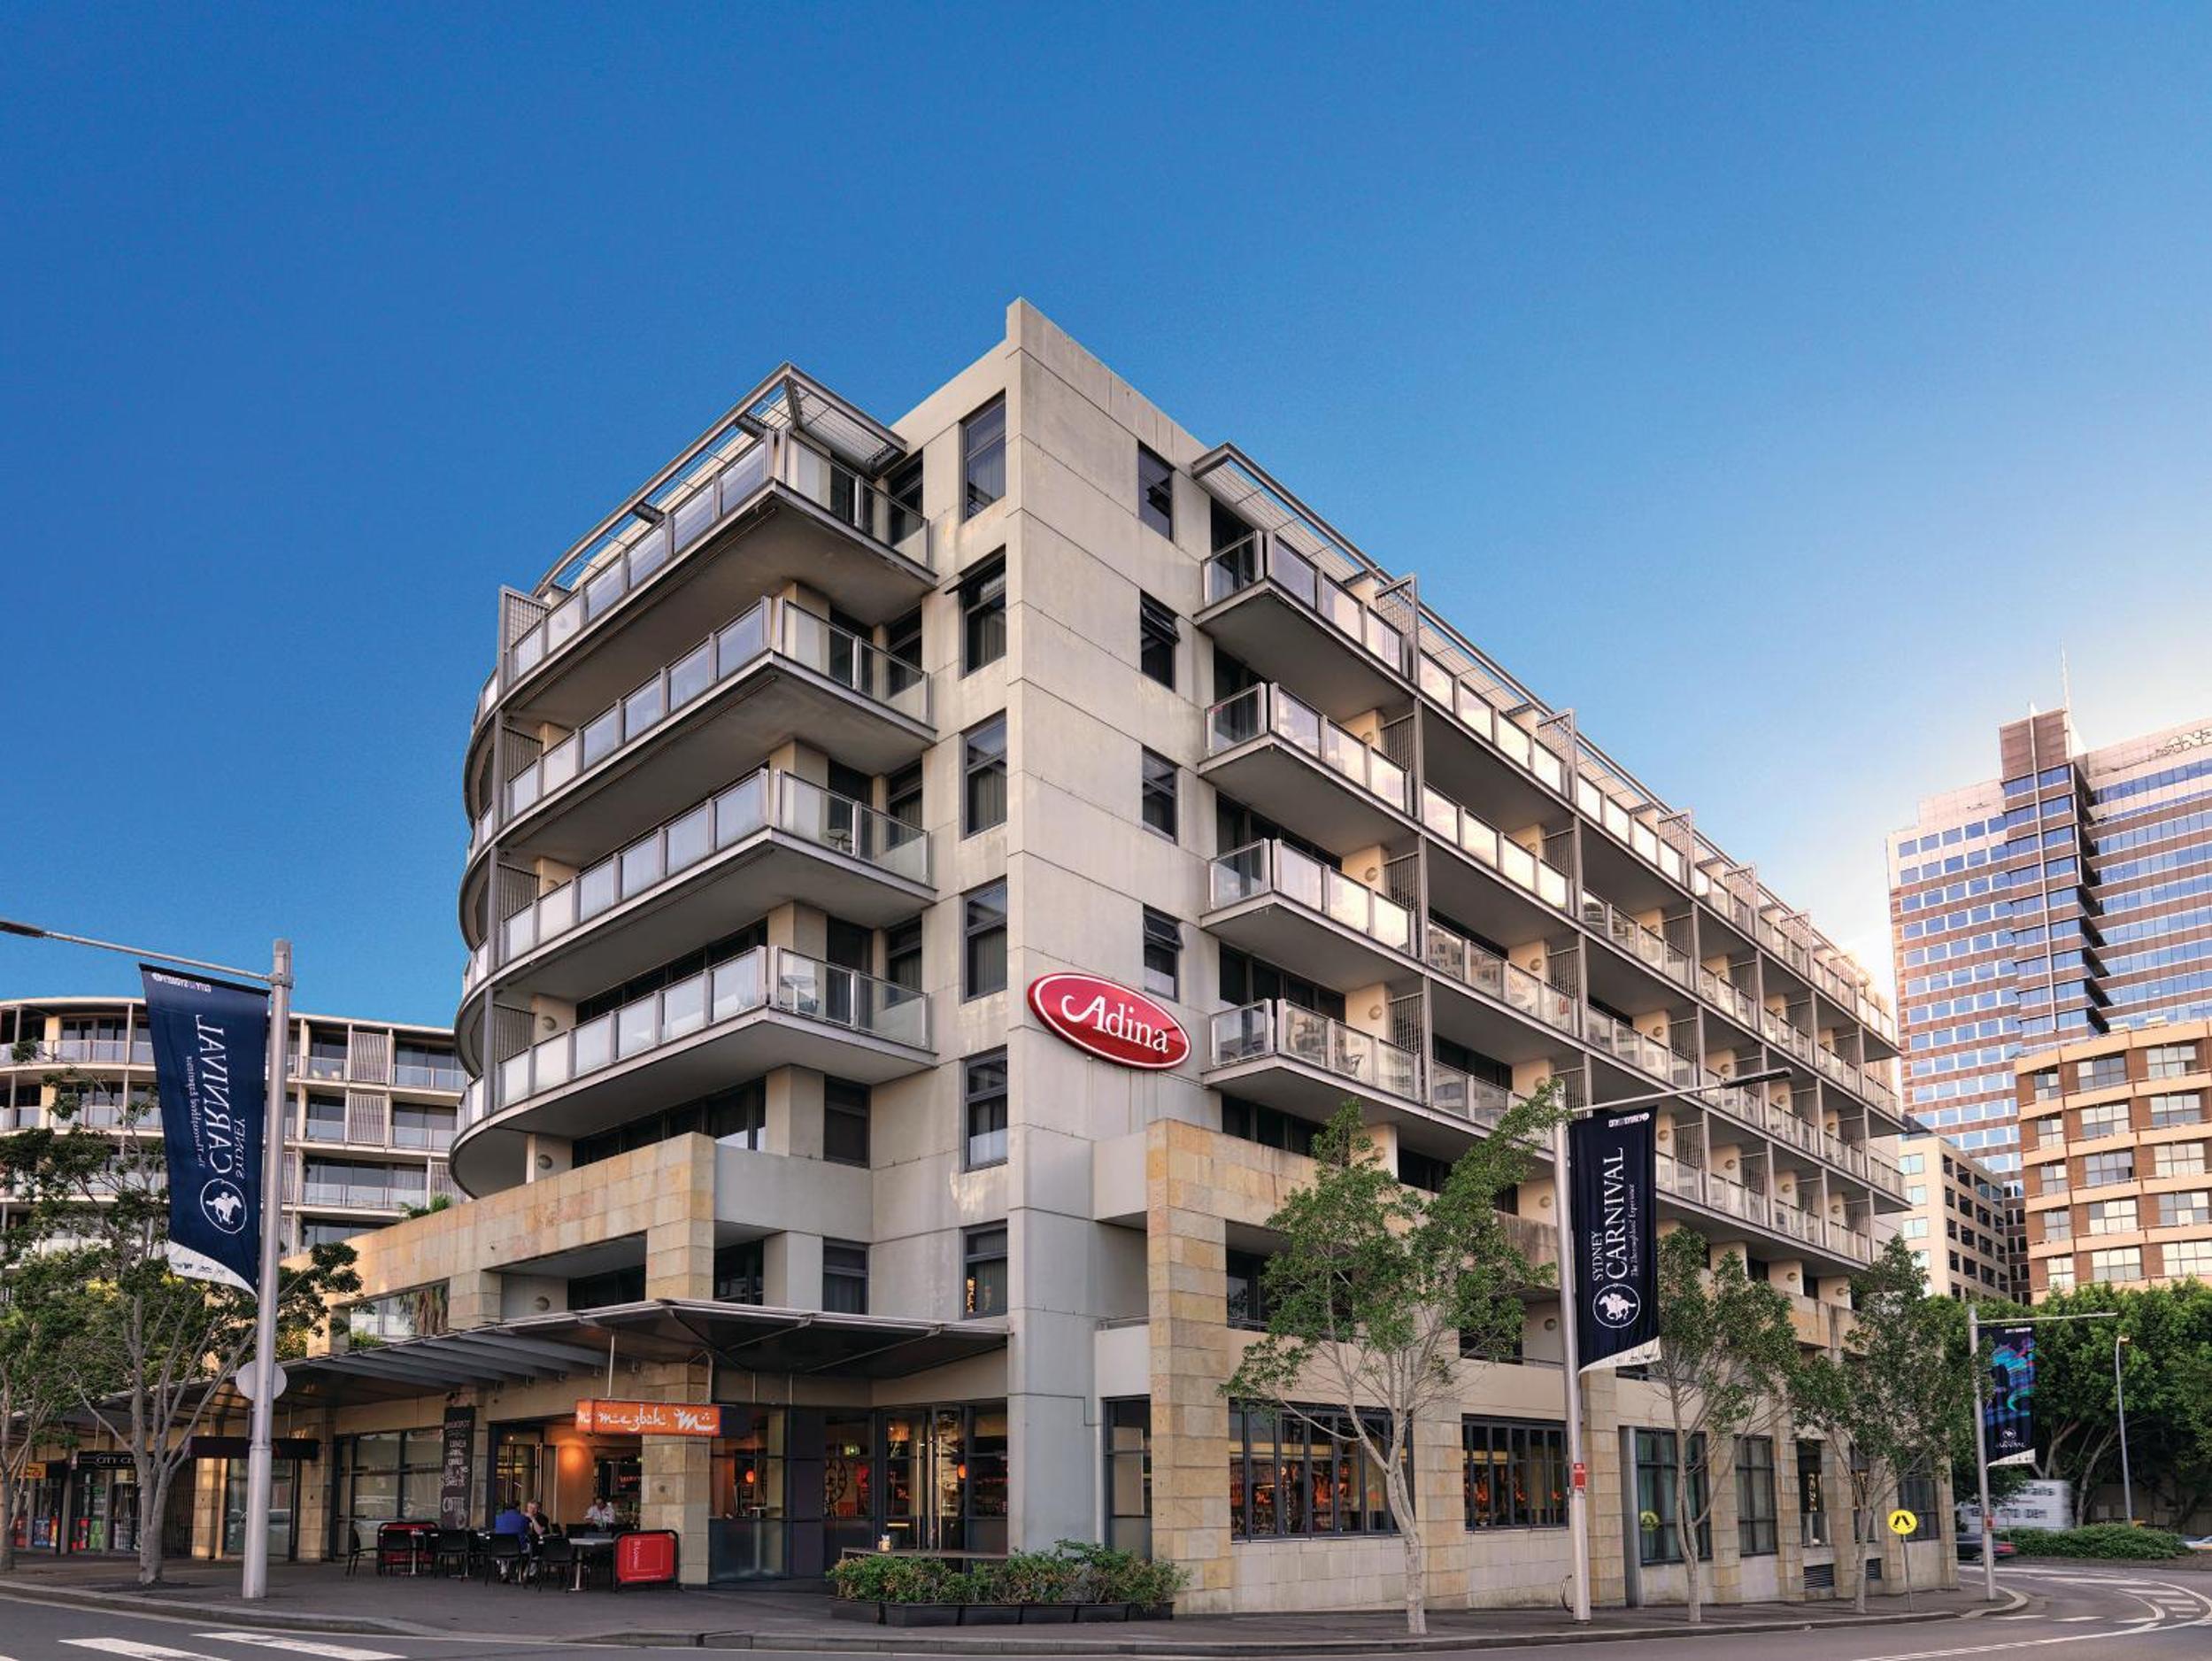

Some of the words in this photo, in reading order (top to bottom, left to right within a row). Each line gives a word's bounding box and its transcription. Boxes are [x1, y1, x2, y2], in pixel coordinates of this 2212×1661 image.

[1061, 994, 1168, 1054] Adina
[1603, 1147, 1628, 1279] CARNIVAL
[1591, 1231, 1603, 1281] SYDNEY
